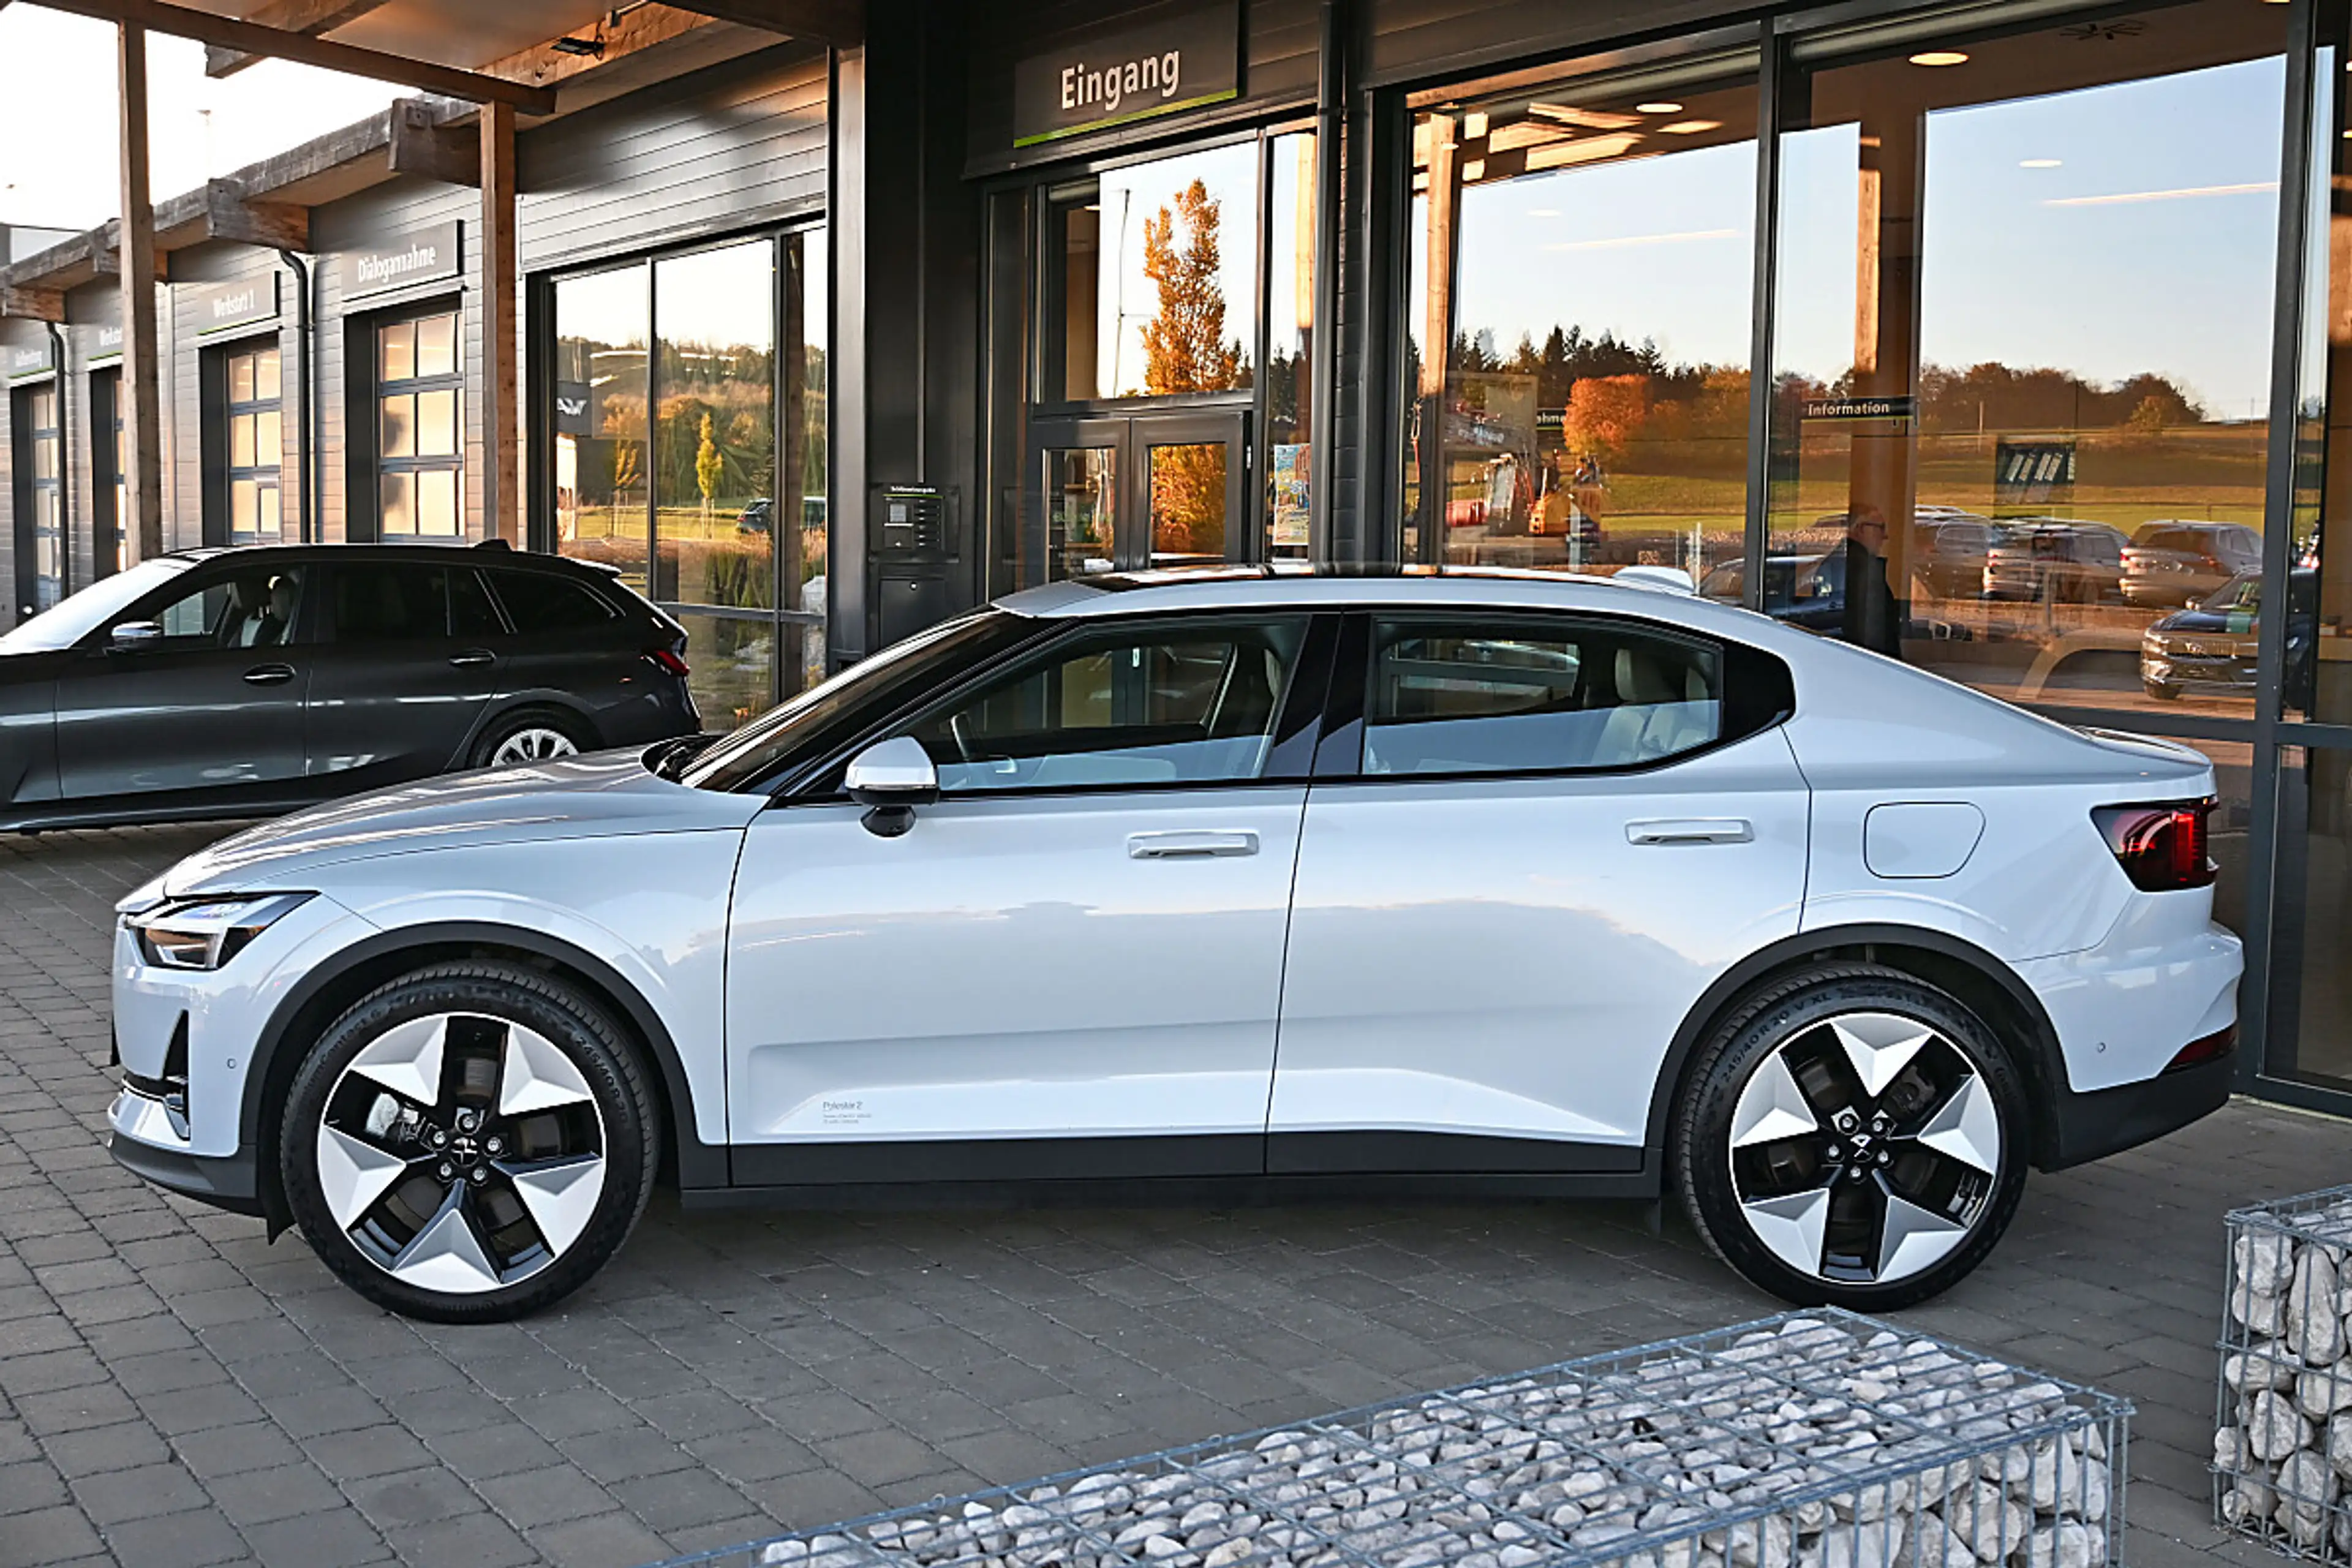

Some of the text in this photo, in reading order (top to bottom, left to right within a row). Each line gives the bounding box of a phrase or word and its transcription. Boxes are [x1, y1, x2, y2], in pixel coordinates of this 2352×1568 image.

[1061, 50, 1180, 111] Eingang
[358, 244, 436, 283] Dialogannahme
[1807, 401, 1890, 417] Information
[1721, 1036, 1760, 1083] 245/40
